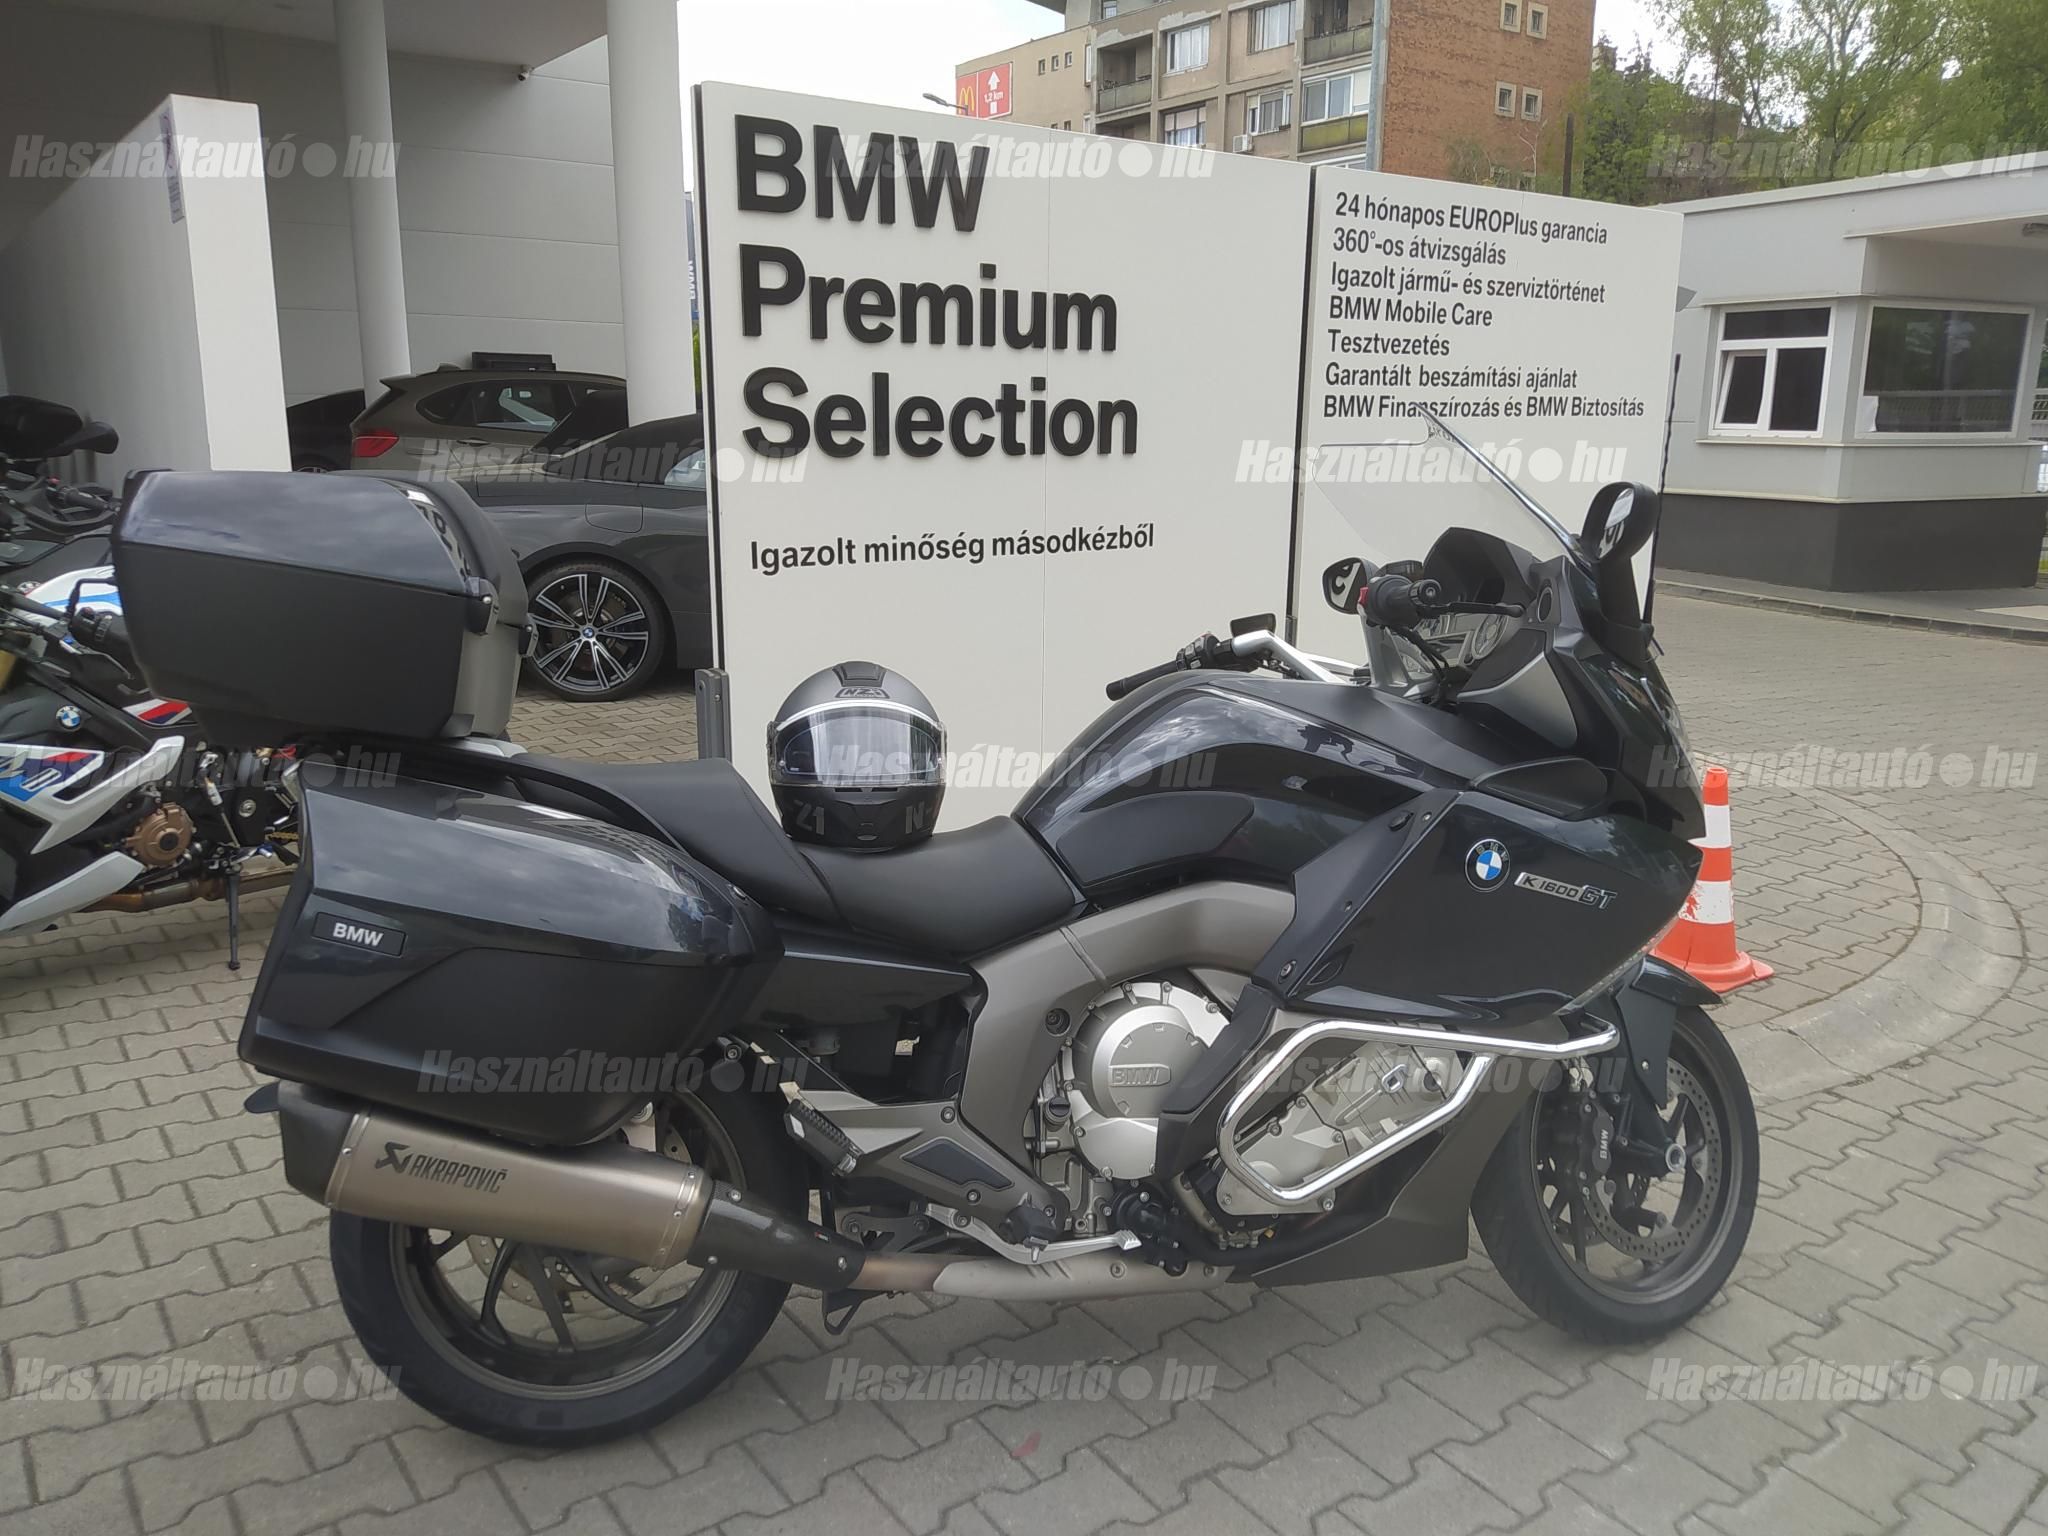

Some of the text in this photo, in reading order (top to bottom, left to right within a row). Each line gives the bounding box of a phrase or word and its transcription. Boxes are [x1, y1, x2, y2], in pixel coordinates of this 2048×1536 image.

[993, 90, 1004, 100] km
[735, 114, 990, 233] BMW
[1335, 191, 1608, 244] 24 hónapos EUROPlus garancia
[1409, 235, 1506, 268] átvizsgálás
[738, 243, 1118, 351] Premium
[1331, 261, 1395, 292] Igazolt
[1462, 272, 1482, 295] és
[1486, 276, 1606, 303] szerviztörténet
[1329, 295, 1493, 326] BMW Mobile Care
[1327, 329, 1450, 355] Tesztvezetés
[1325, 361, 1578, 393] Garantált beszámítási ajánlat
[741, 366, 1139, 458] Selection
[1323, 395, 1374, 418] BMW
[1503, 397, 1522, 417] és
[1526, 397, 1568, 417] BMW
[1571, 397, 1644, 417] Biztosítás
[751, 523, 1154, 576] Igazolt minőség másodkézből
[333, 922, 384, 947] BMW
[1111, 1067, 1161, 1085] BMW
[1600, 1129, 1609, 1159] BMW
